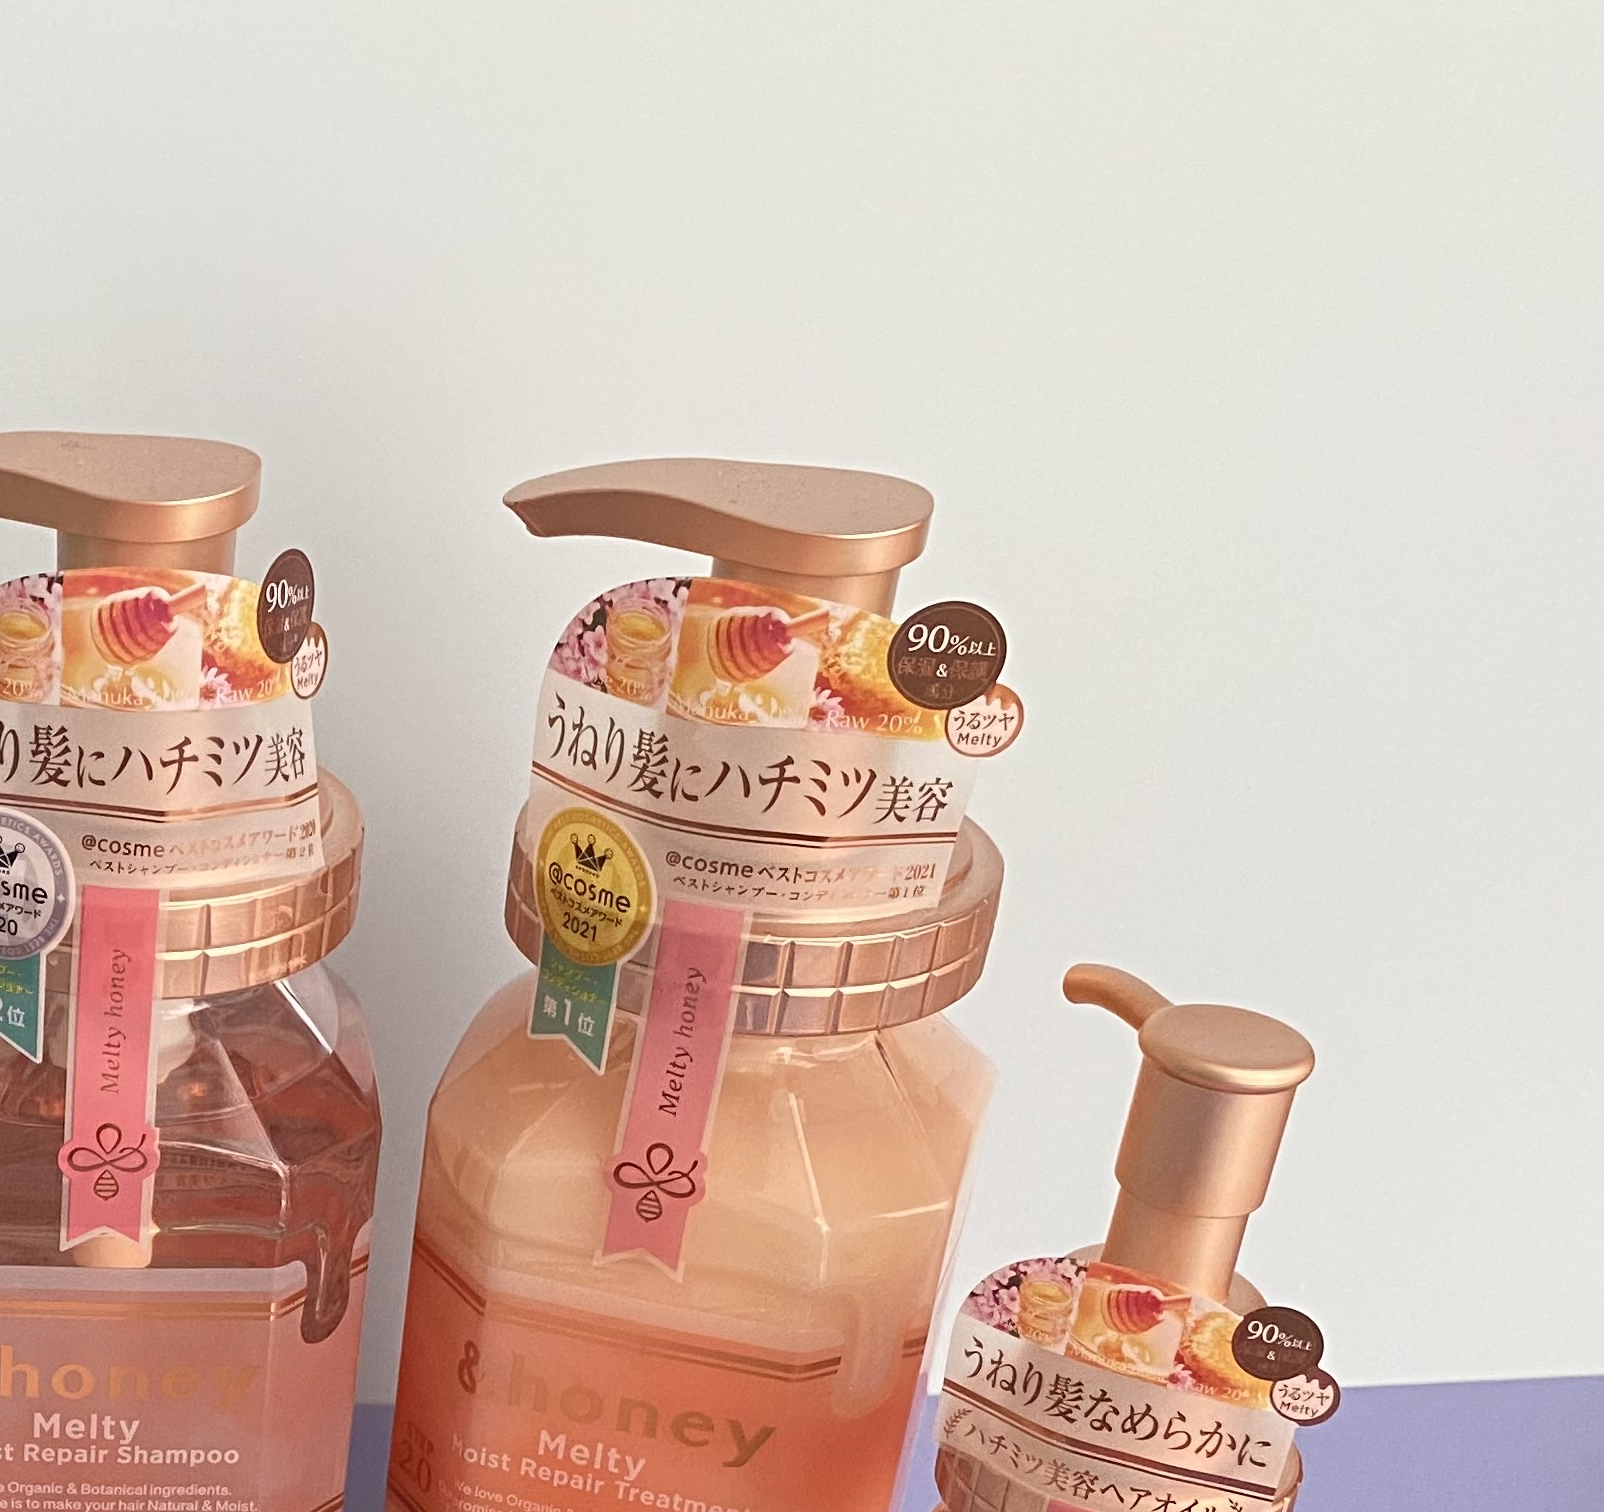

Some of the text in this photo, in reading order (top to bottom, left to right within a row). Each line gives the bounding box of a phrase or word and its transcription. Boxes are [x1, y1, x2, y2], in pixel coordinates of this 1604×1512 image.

[907, 623, 997, 656] 90%以上
[824, 709, 868, 731] Raw
[875, 712, 924, 736] 20%
[953, 709, 1015, 731] うるツヤ
[956, 732, 1003, 748] Melty
[548, 691, 955, 828] うねり髪にハチミツ美容
[81, 834, 165, 858] @cosme
[666, 850, 753, 878] @cosme
[549, 862, 631, 913] @cosme
[562, 911, 597, 943] 2021
[100, 948, 134, 1096] Melty honey
[543, 994, 596, 1037] 第1位
[658, 966, 707, 1117] Melty honey
[458, 1339, 776, 1468] &honey
[963, 1335, 1273, 1469] うねり髪なめらかに
[1277, 1382, 1332, 1407] うるツヤ
[1279, 1400, 1319, 1418] Melty
[33, 1411, 141, 1446] Melty
[23, 1443, 109, 1466] Repair
[117, 1445, 240, 1468] Shampoo
[452, 1432, 512, 1472] Moist
[519, 1457, 605, 1495] Repair
[537, 1429, 647, 1482] Melty
[7, 1481, 64, 1497] Organic
[67, 1483, 78, 1495] &
[81, 1483, 147, 1497] Botanical
[150, 1484, 233, 1499] ingredients.
[26, 1497, 40, 1509] to
[43, 1498, 82, 1511] make
[118, 1500, 145, 1512] hair
[147, 1500, 199, 1512] Natural
[215, 1500, 259, 1512] Moist.
[474, 1485, 504, 1503] love
